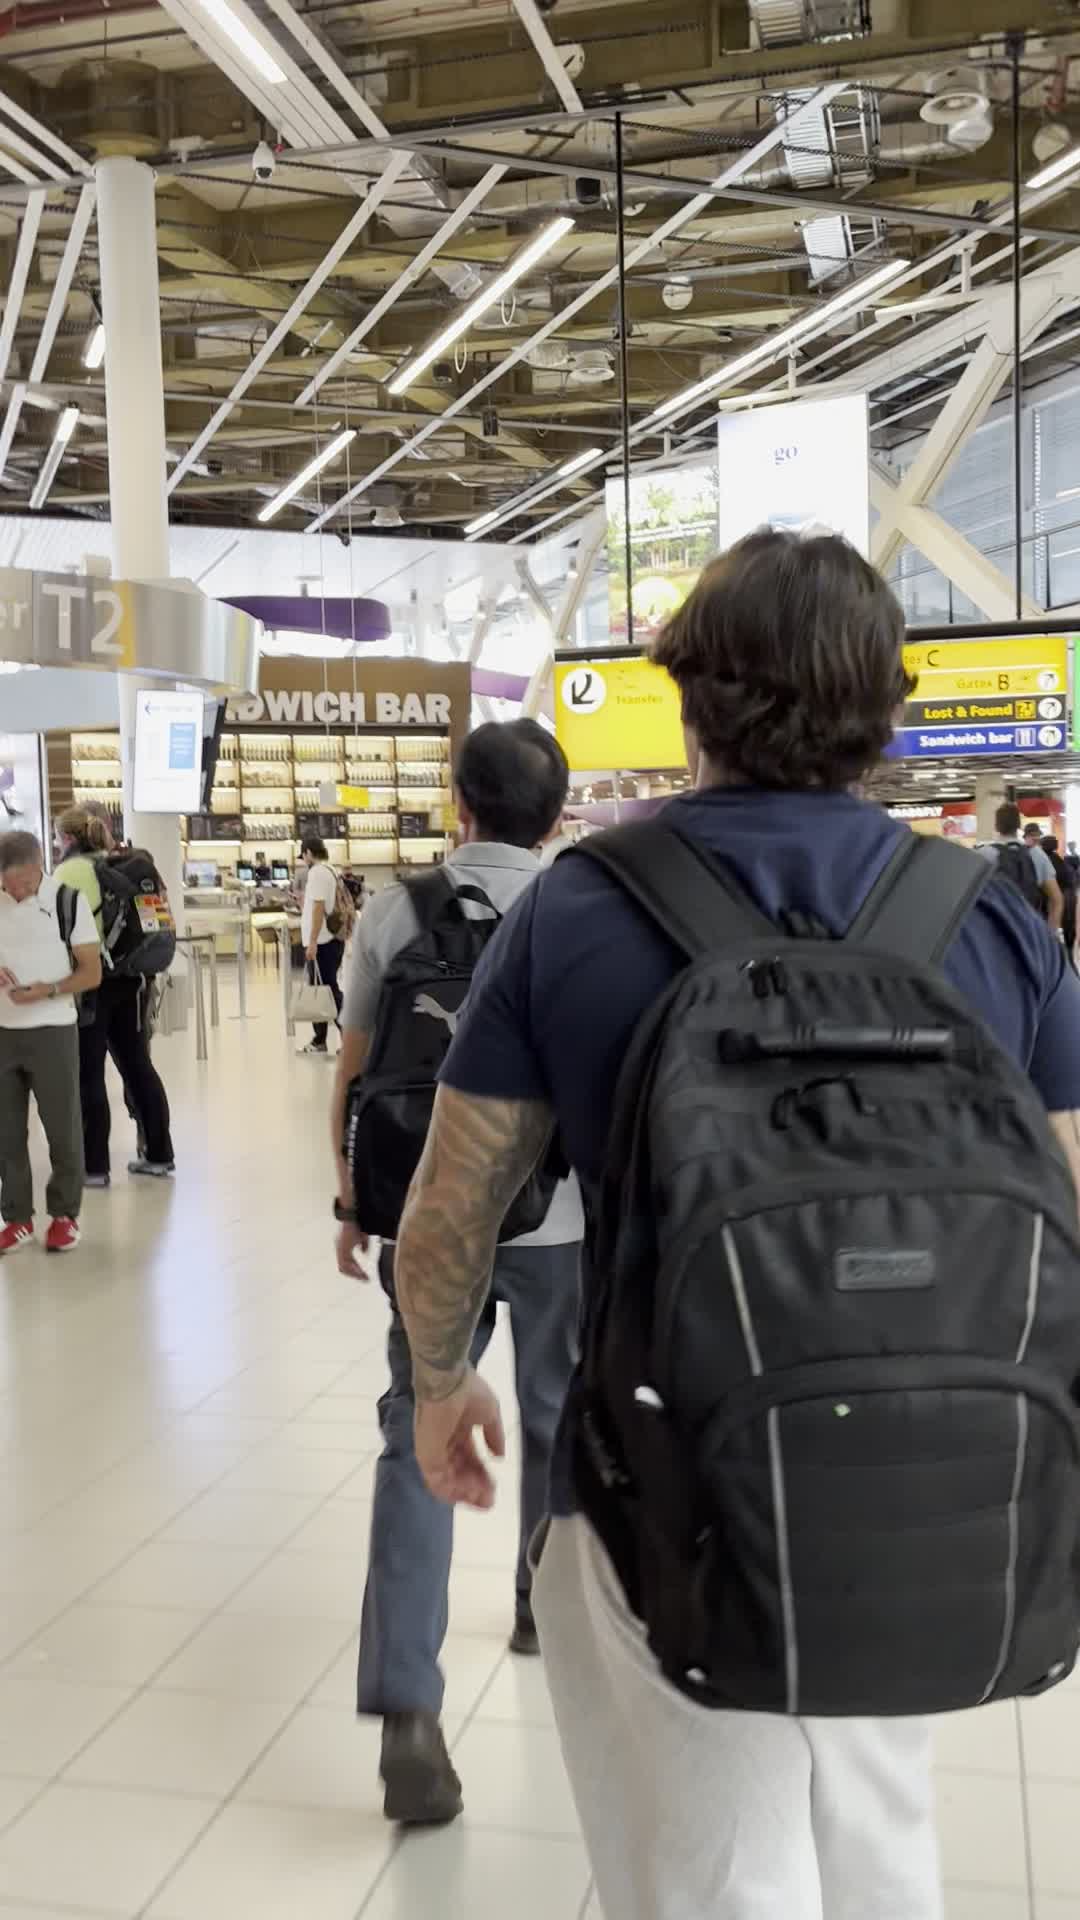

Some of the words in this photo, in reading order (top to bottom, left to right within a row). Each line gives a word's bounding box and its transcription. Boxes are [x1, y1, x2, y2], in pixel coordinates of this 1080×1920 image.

[41, 583, 125, 654] T2
[927, 650, 940, 667] C
[998, 674, 1010, 691] B
[375, 692, 450, 723] BAR
[924, 706, 953, 720] Lost
[956, 705, 968, 717] &
[970, 703, 1013, 718] Found
[920, 733, 986, 747] Sandwich
[989, 731, 1013, 744] bar
